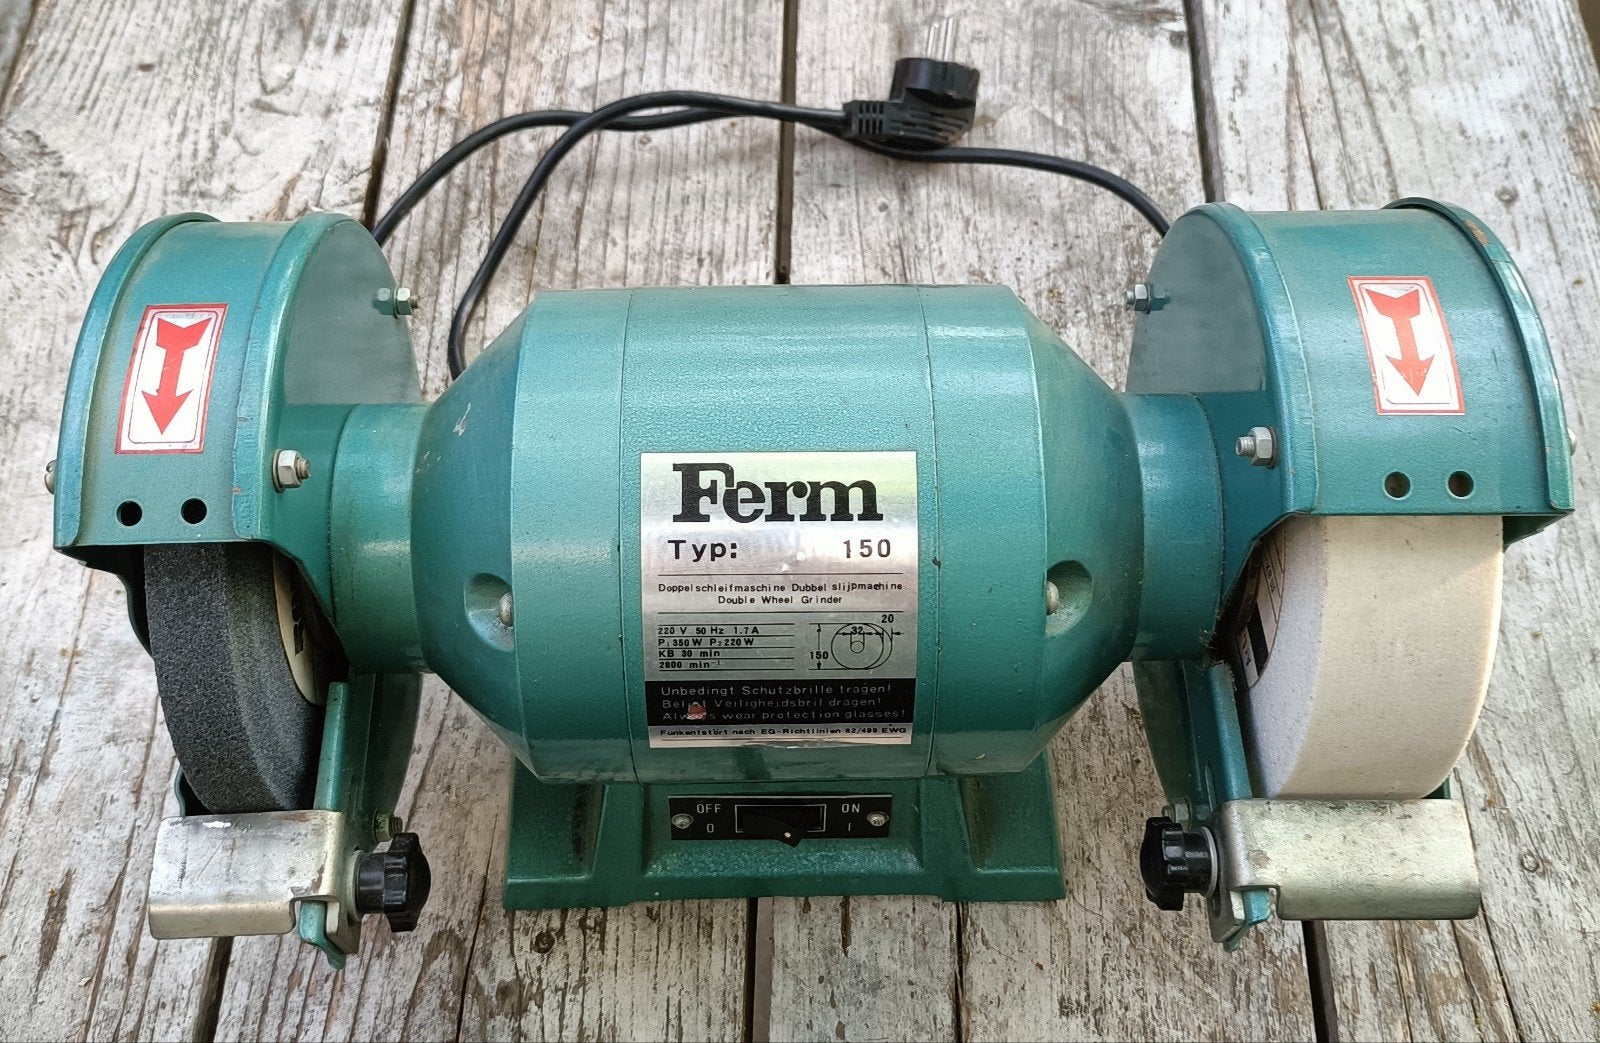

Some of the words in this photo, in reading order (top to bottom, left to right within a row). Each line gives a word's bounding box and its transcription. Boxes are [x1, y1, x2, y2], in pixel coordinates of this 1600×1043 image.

[672, 462, 884, 524] Ferm
[668, 539, 738, 563] Typ:
[842, 538, 891, 559] 150
[658, 583, 786, 593] Doppelschleifmaschine
[791, 583, 827, 592] Dubbel
[832, 582, 903, 592] slijpmachine
[717, 595, 756, 605] Double
[761, 595, 793, 604] Wheel
[801, 595, 842, 604] Grinder
[881, 613, 894, 624] 20
[658, 626, 675, 635] 220
[680, 626, 688, 635] V
[695, 626, 707, 635] 50
[710, 626, 725, 635] Hz
[851, 626, 863, 635] 32
[659, 649, 674, 658] KB
[681, 649, 693, 658] 30
[699, 649, 720, 658] min
[809, 650, 829, 660] 150
[659, 661, 682, 669] 2800
[661, 686, 734, 697] Unbedingt
[742, 684, 833, 695] Schutzbrille
[840, 684, 891, 695] tragen!
[828, 698, 880, 707] dragen!
[762, 710, 840, 720] protection
[844, 709, 905, 719] glasses!
[696, 803, 722, 814] OFF
[841, 803, 860, 814] ON
